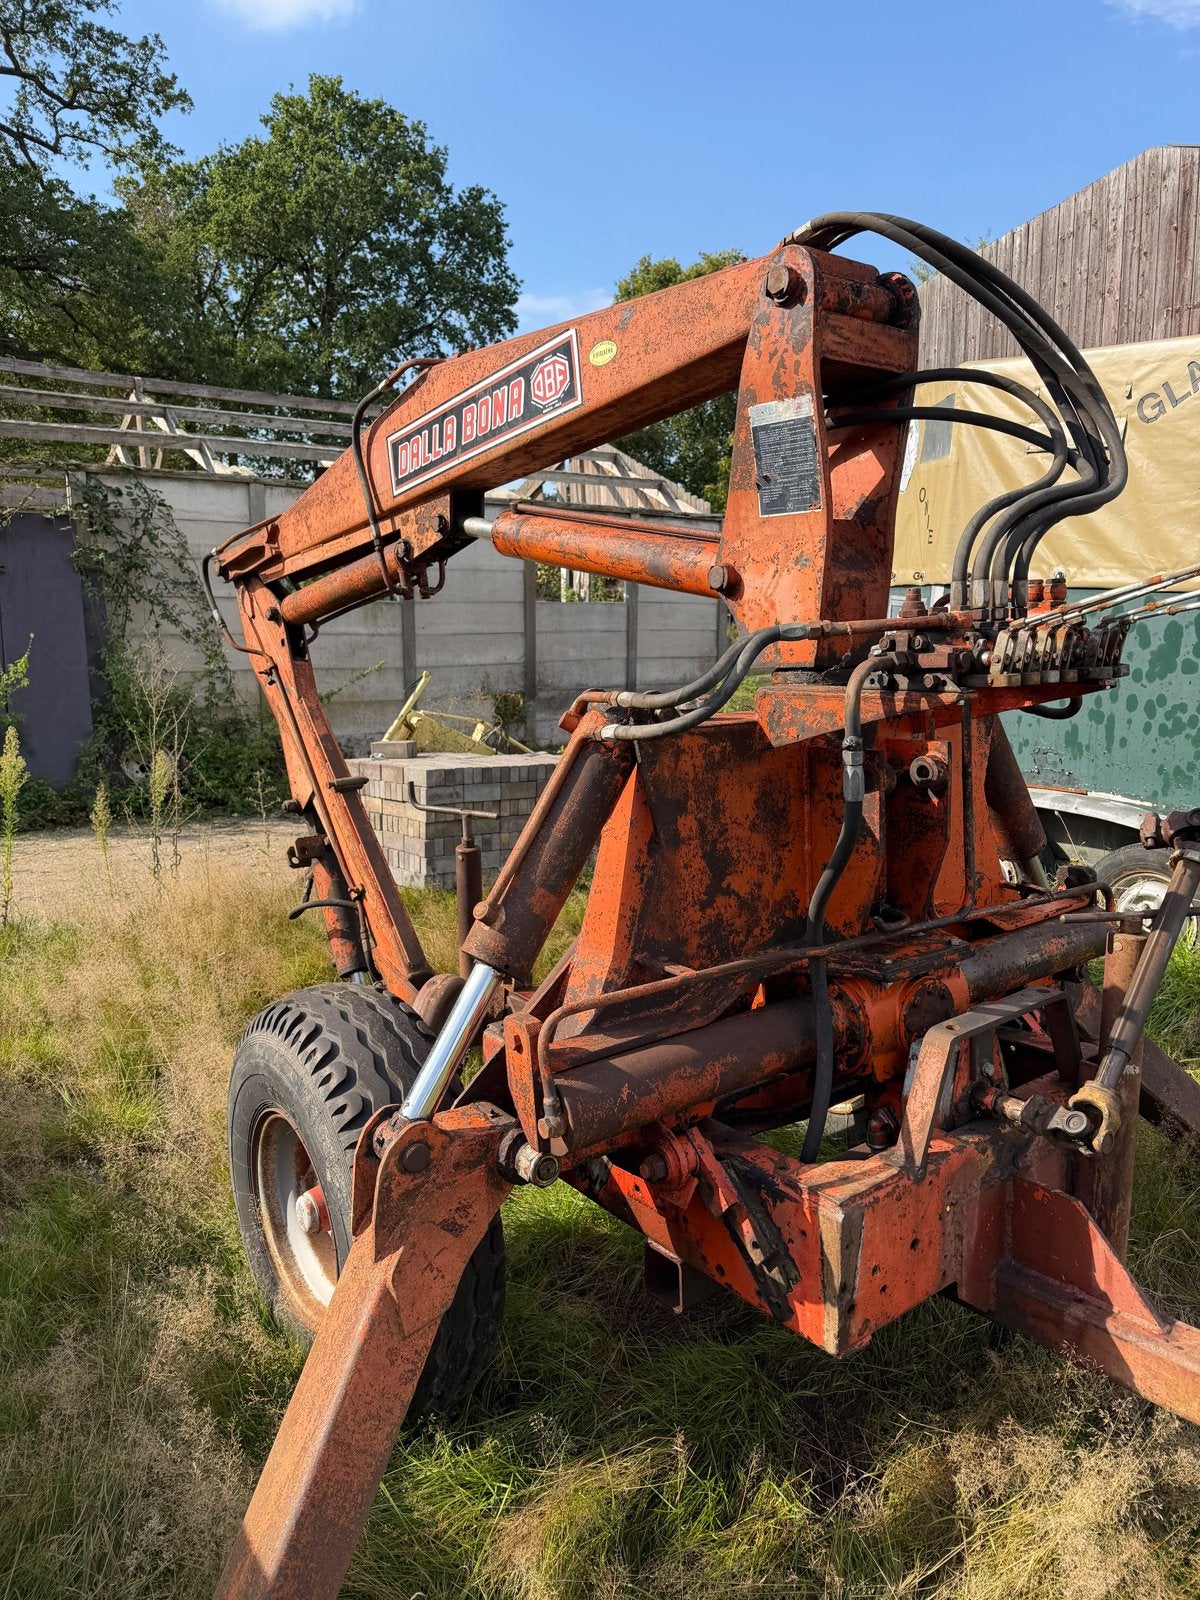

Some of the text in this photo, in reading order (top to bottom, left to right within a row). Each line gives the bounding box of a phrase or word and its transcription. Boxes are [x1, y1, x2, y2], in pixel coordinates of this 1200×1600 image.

[533, 363, 566, 399] DBF
[398, 377, 525, 479] DALLA BONA
